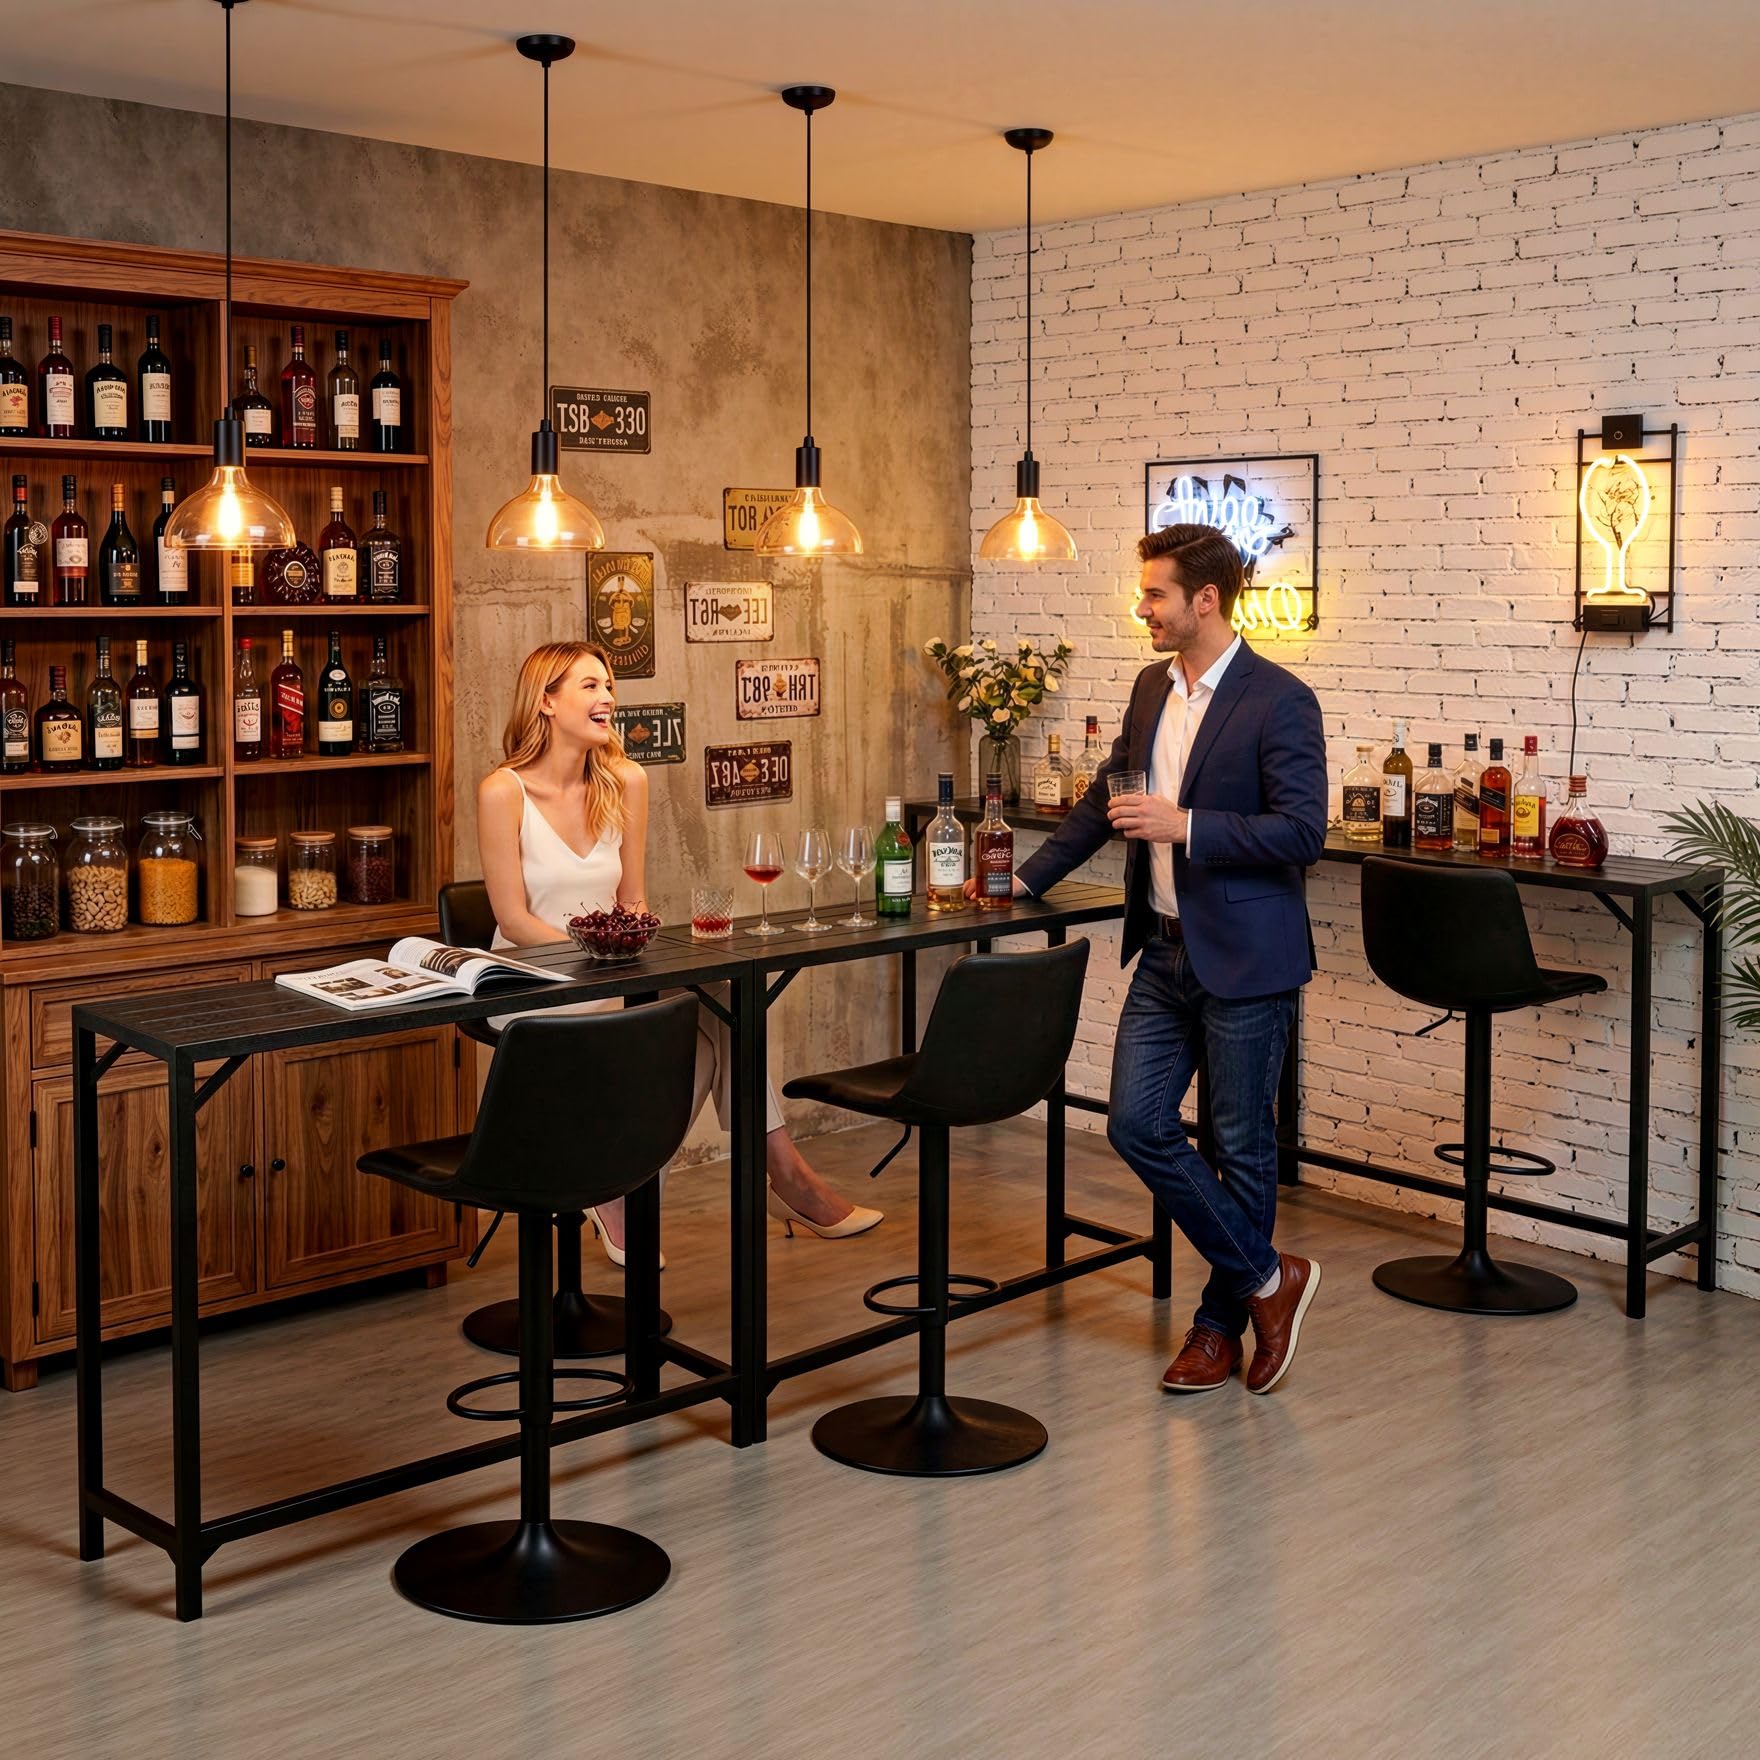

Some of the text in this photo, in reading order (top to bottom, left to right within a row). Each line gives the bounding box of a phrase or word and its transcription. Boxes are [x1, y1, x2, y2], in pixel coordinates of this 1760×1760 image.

[557, 403, 646, 436] TSB 330
[728, 504, 757, 531] TOR
